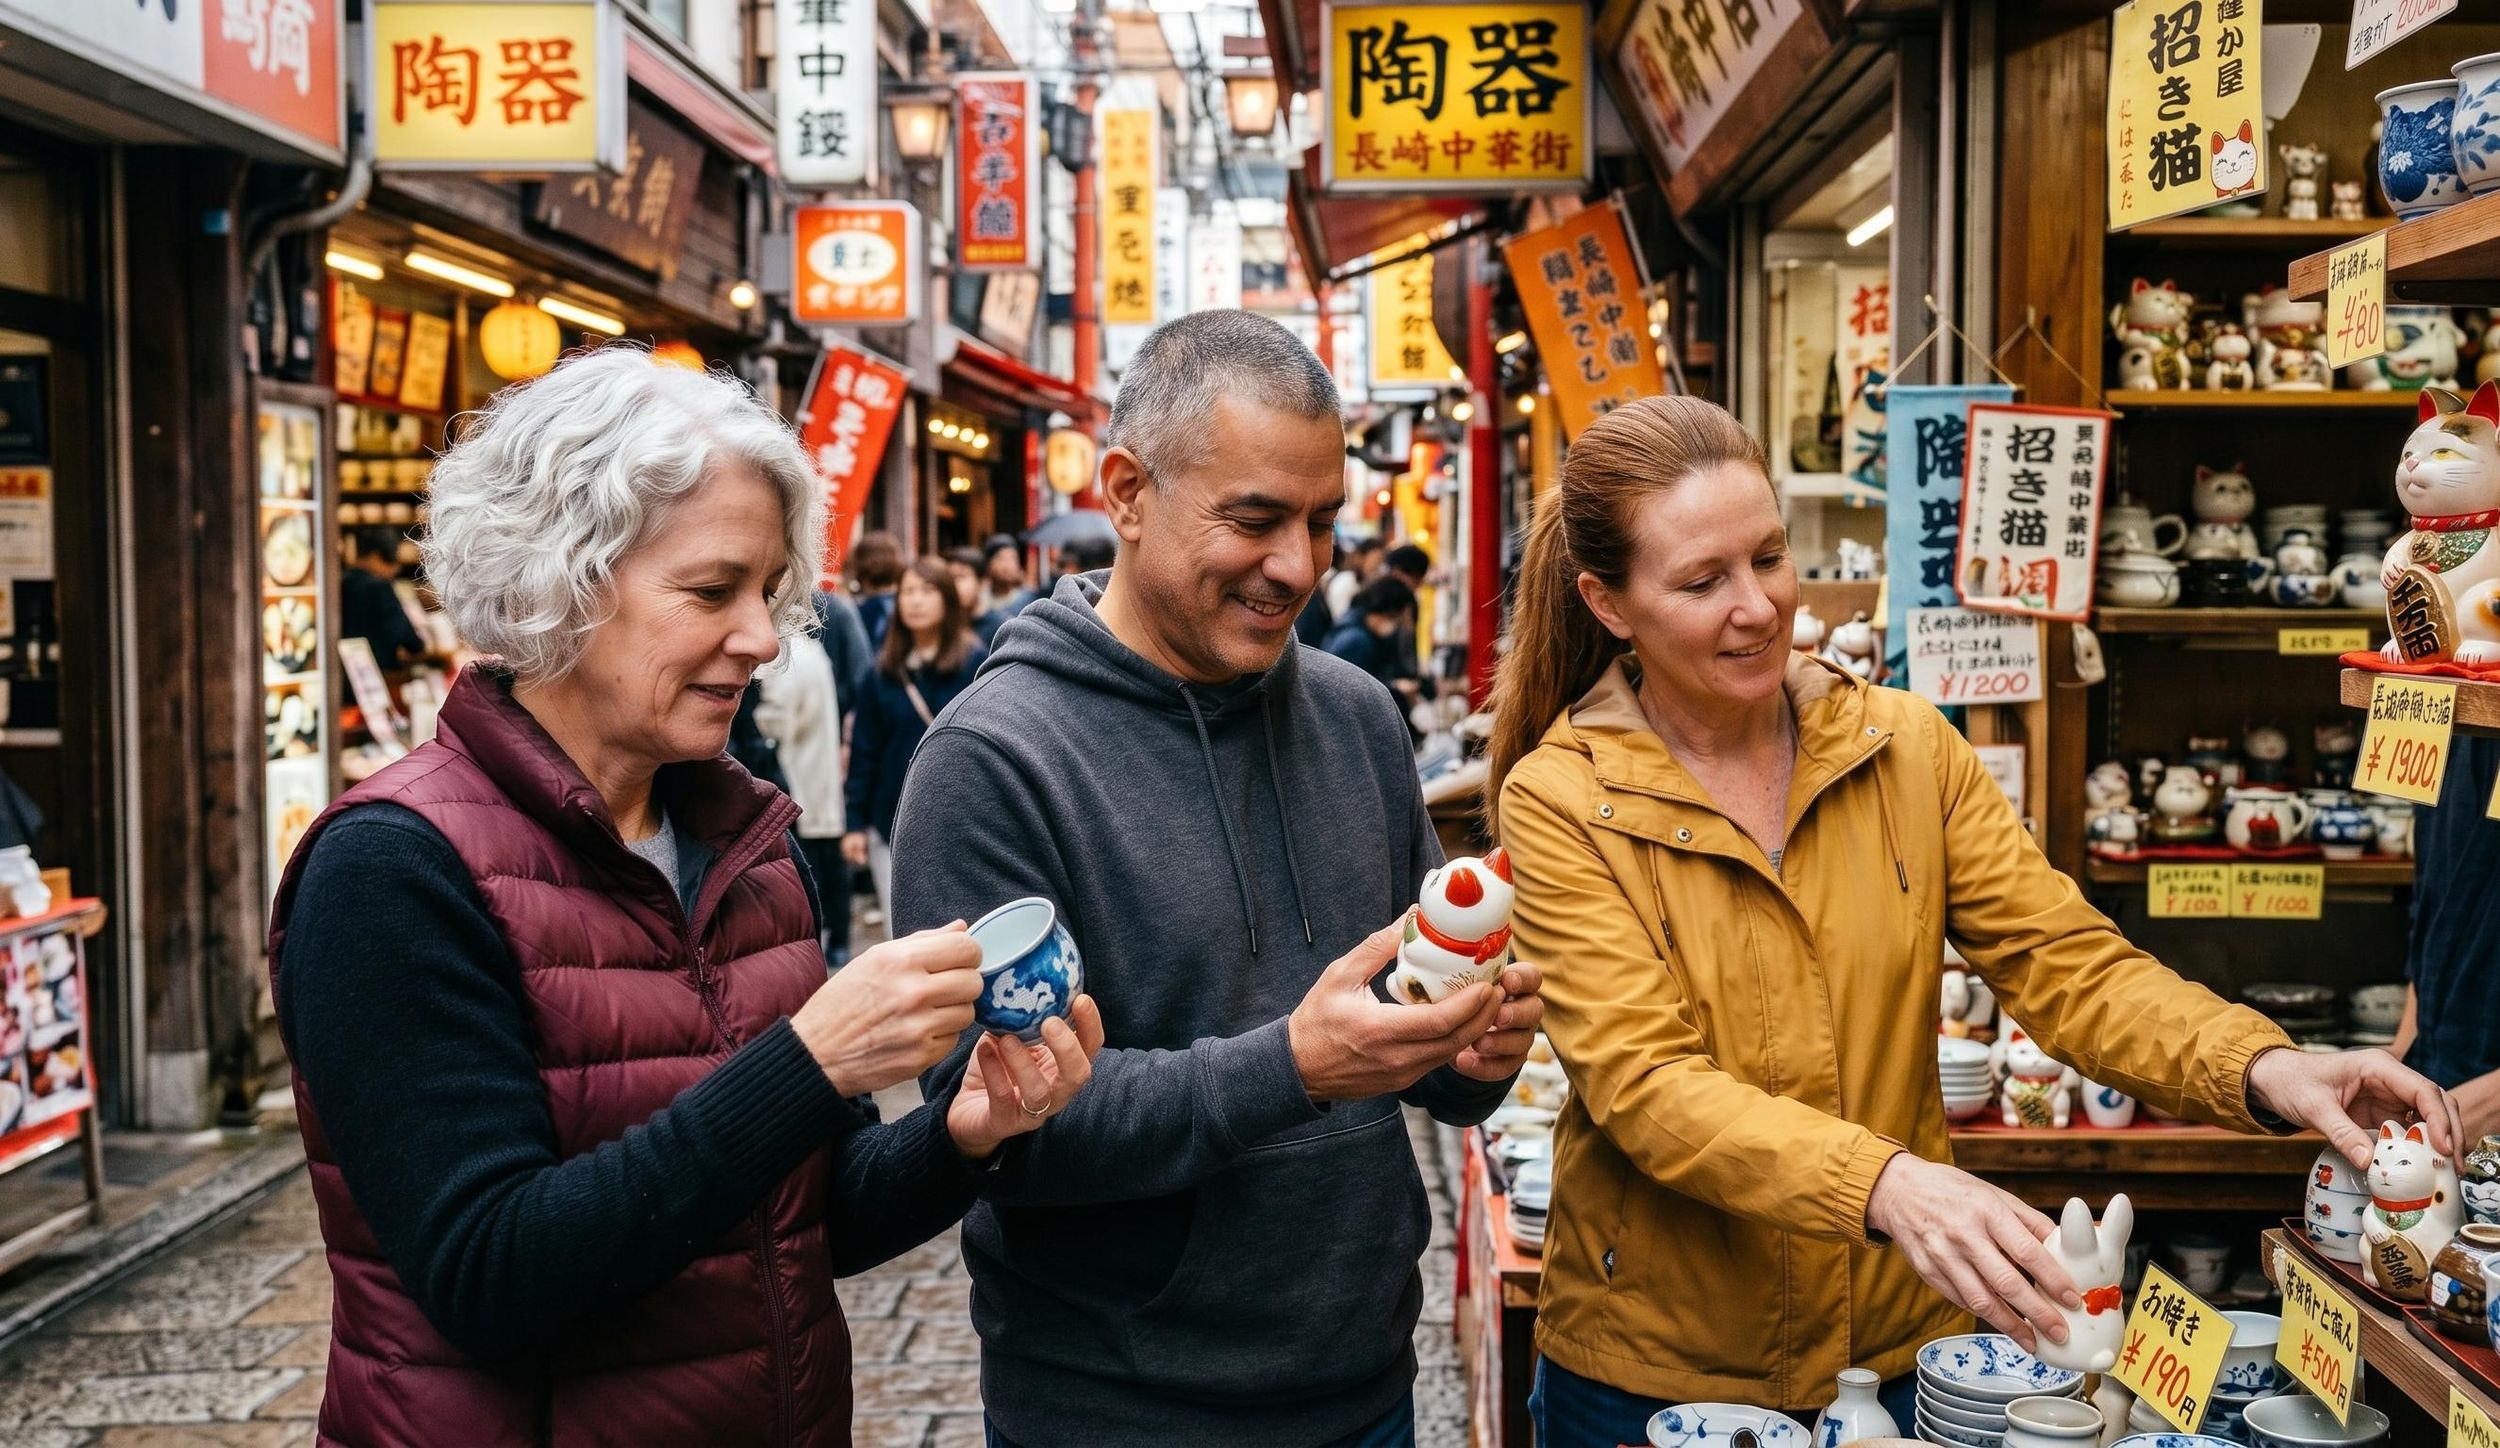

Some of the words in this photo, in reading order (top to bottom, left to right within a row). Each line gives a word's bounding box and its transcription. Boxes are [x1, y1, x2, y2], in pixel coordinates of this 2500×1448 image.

[392, 35, 587, 127] 陶器
[1347, 20, 1572, 122] 陶器
[2148, 1, 2202, 192] 招き猫
[1348, 129, 1573, 172] 長崎中華街
[2000, 423, 2056, 546] 招き猫
[1940, 671, 2030, 700] ¥1200
[2142, 1282, 2200, 1346] お焼き
